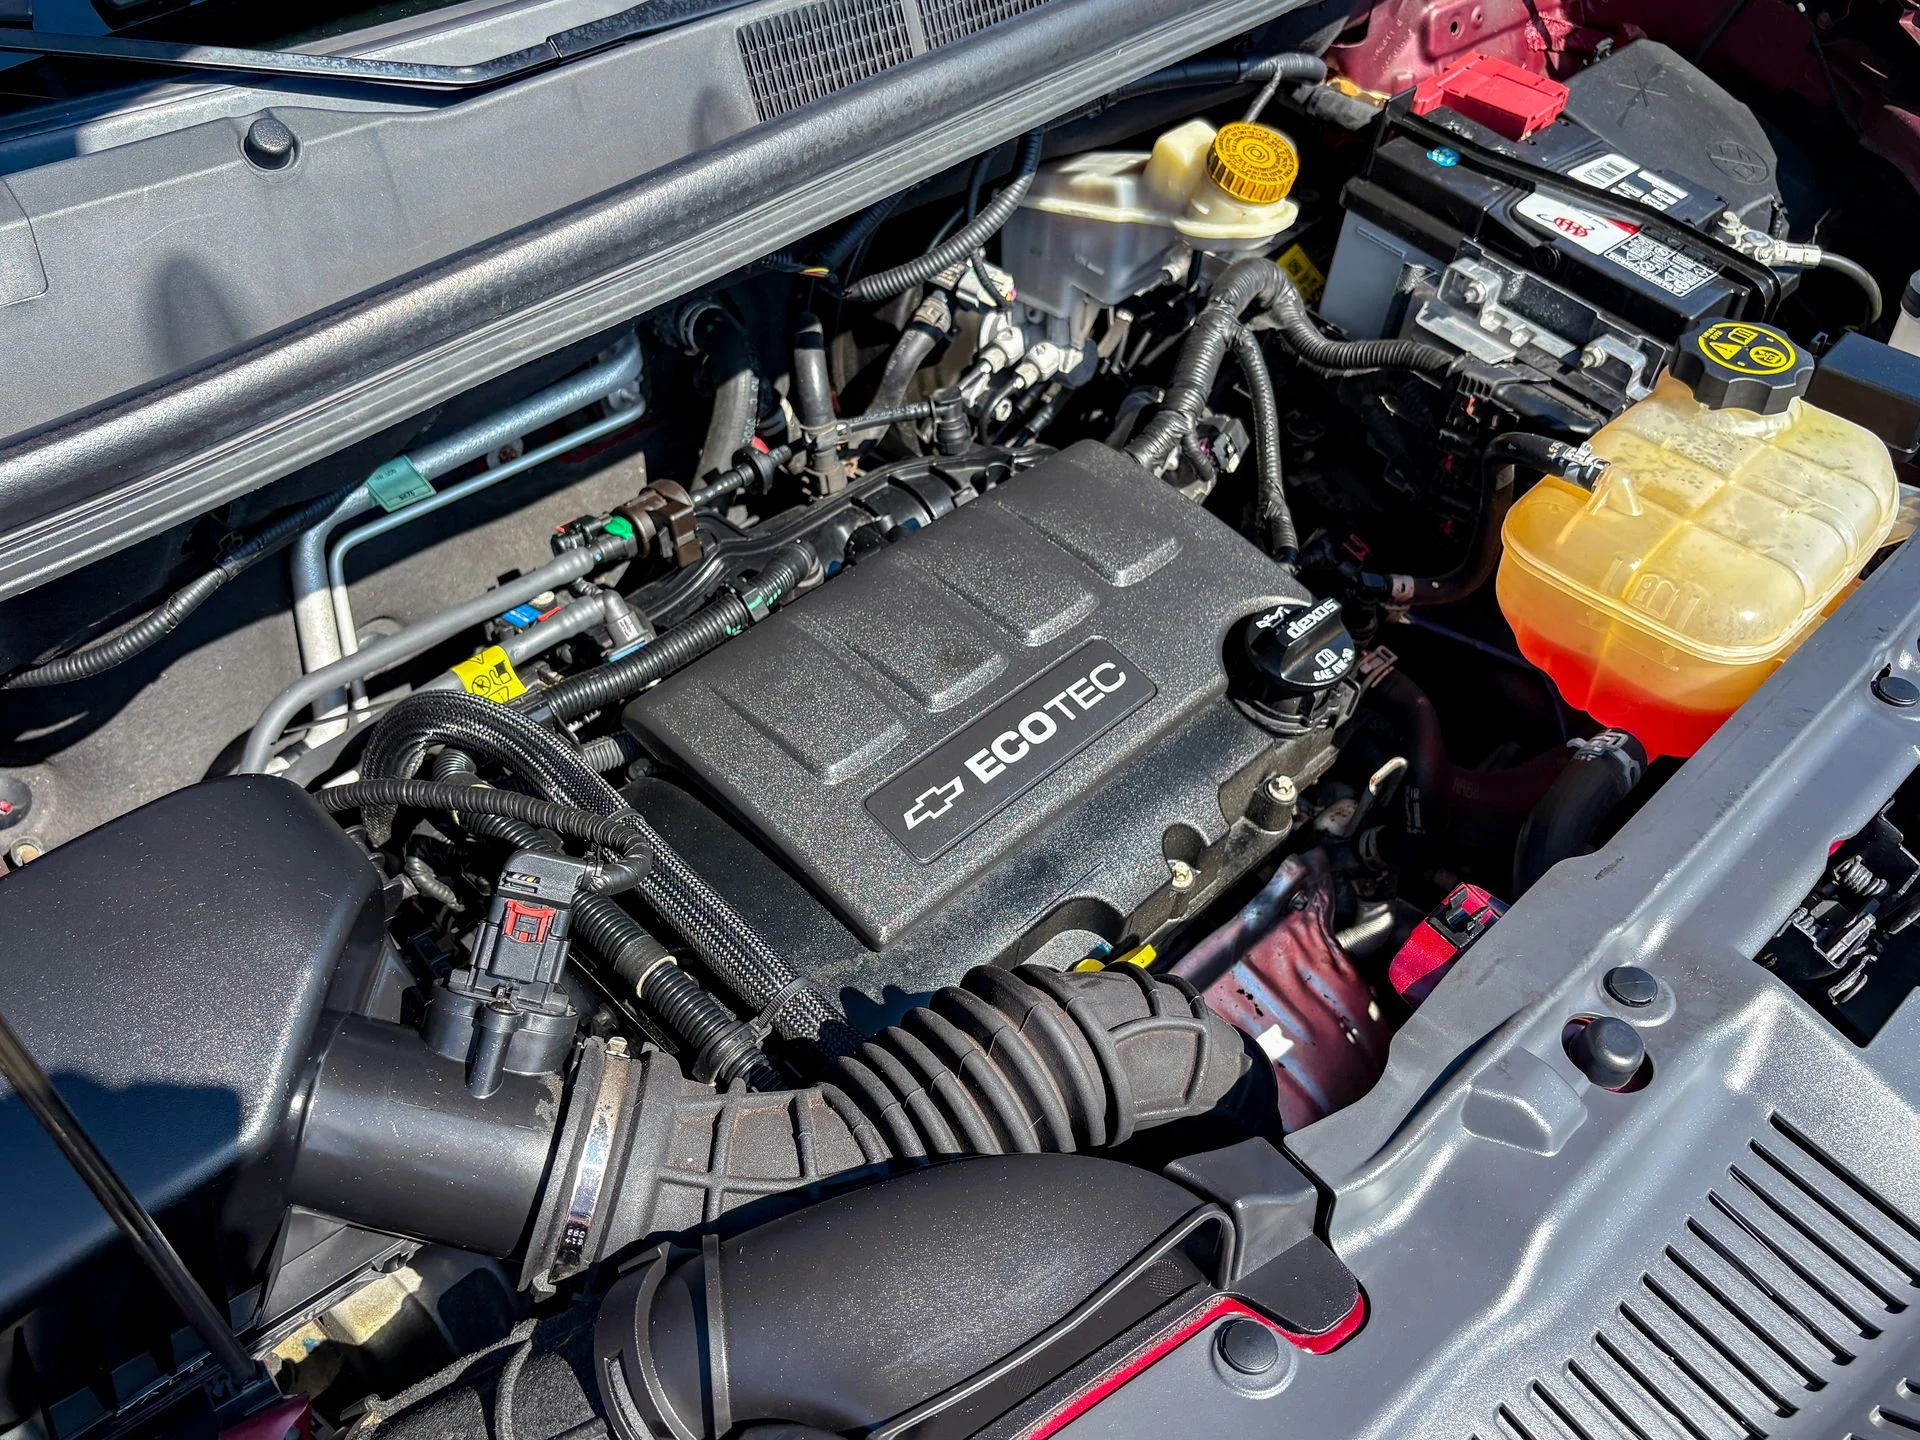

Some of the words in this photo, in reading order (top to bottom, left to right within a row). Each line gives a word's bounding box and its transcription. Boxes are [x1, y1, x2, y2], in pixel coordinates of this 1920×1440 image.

[1286, 598, 1338, 639] dexos
[1313, 668, 1334, 681] SAE
[964, 662, 1127, 784] ECOTEC
